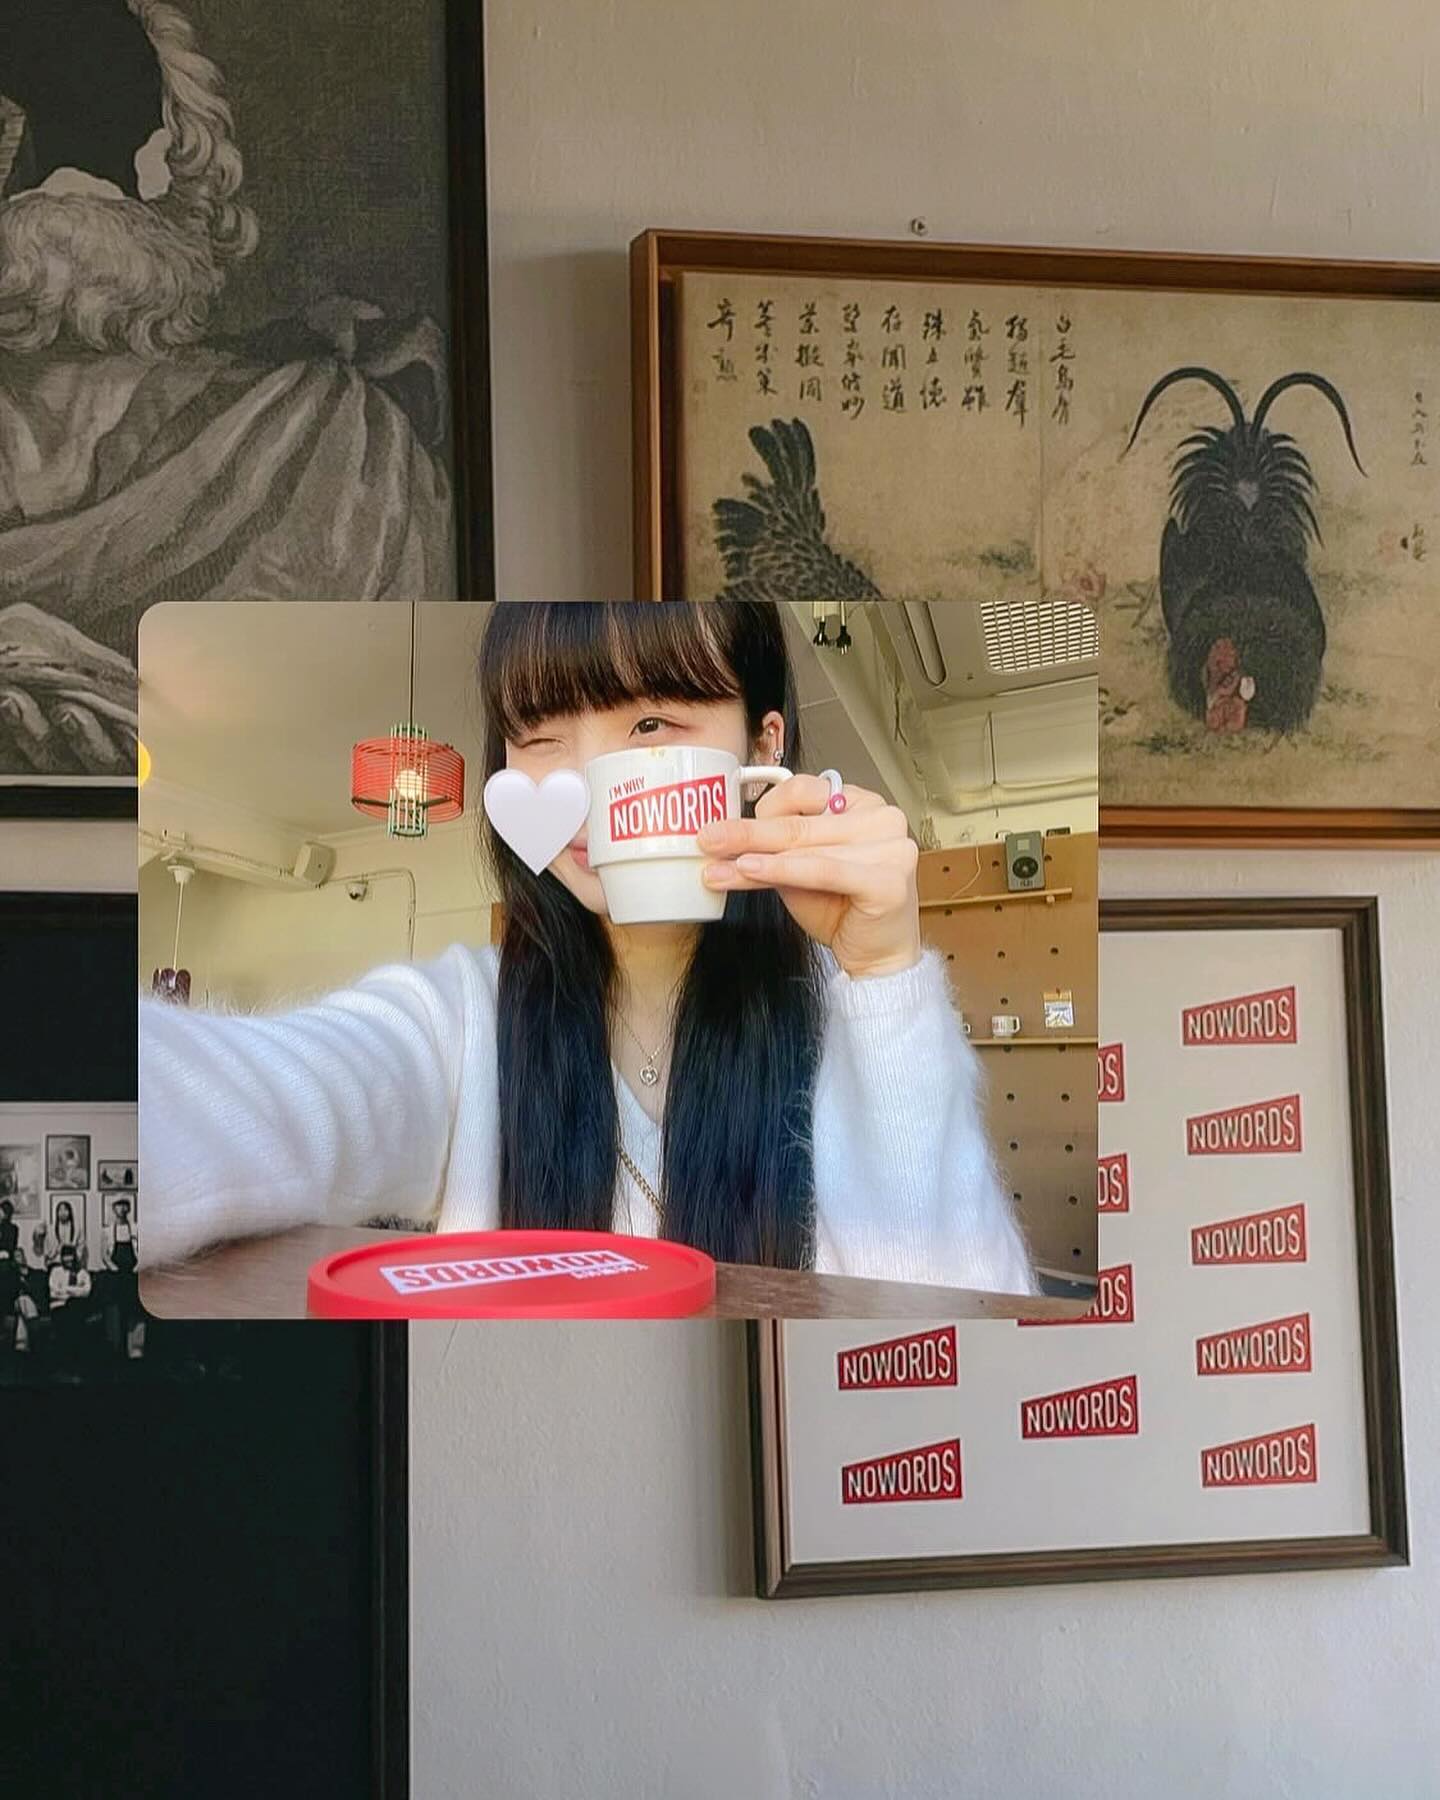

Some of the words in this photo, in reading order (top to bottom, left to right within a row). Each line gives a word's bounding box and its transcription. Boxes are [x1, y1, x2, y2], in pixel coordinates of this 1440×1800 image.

[609, 786, 622, 800] I'M
[623, 776, 645, 795] WHY
[613, 781, 726, 837] NOWORDS
[1188, 996, 1291, 1040] NOWORDS
[1192, 1104, 1296, 1149] NOWORDS
[1197, 1213, 1300, 1259] NOWORDS
[843, 1335, 951, 1384] NOWORDS
[1201, 1323, 1306, 1370] NOWORDS
[1026, 1384, 1134, 1434] NOWORDS
[848, 1449, 956, 1498] NOWORDS
[1206, 1433, 1311, 1481] NOWORDS
